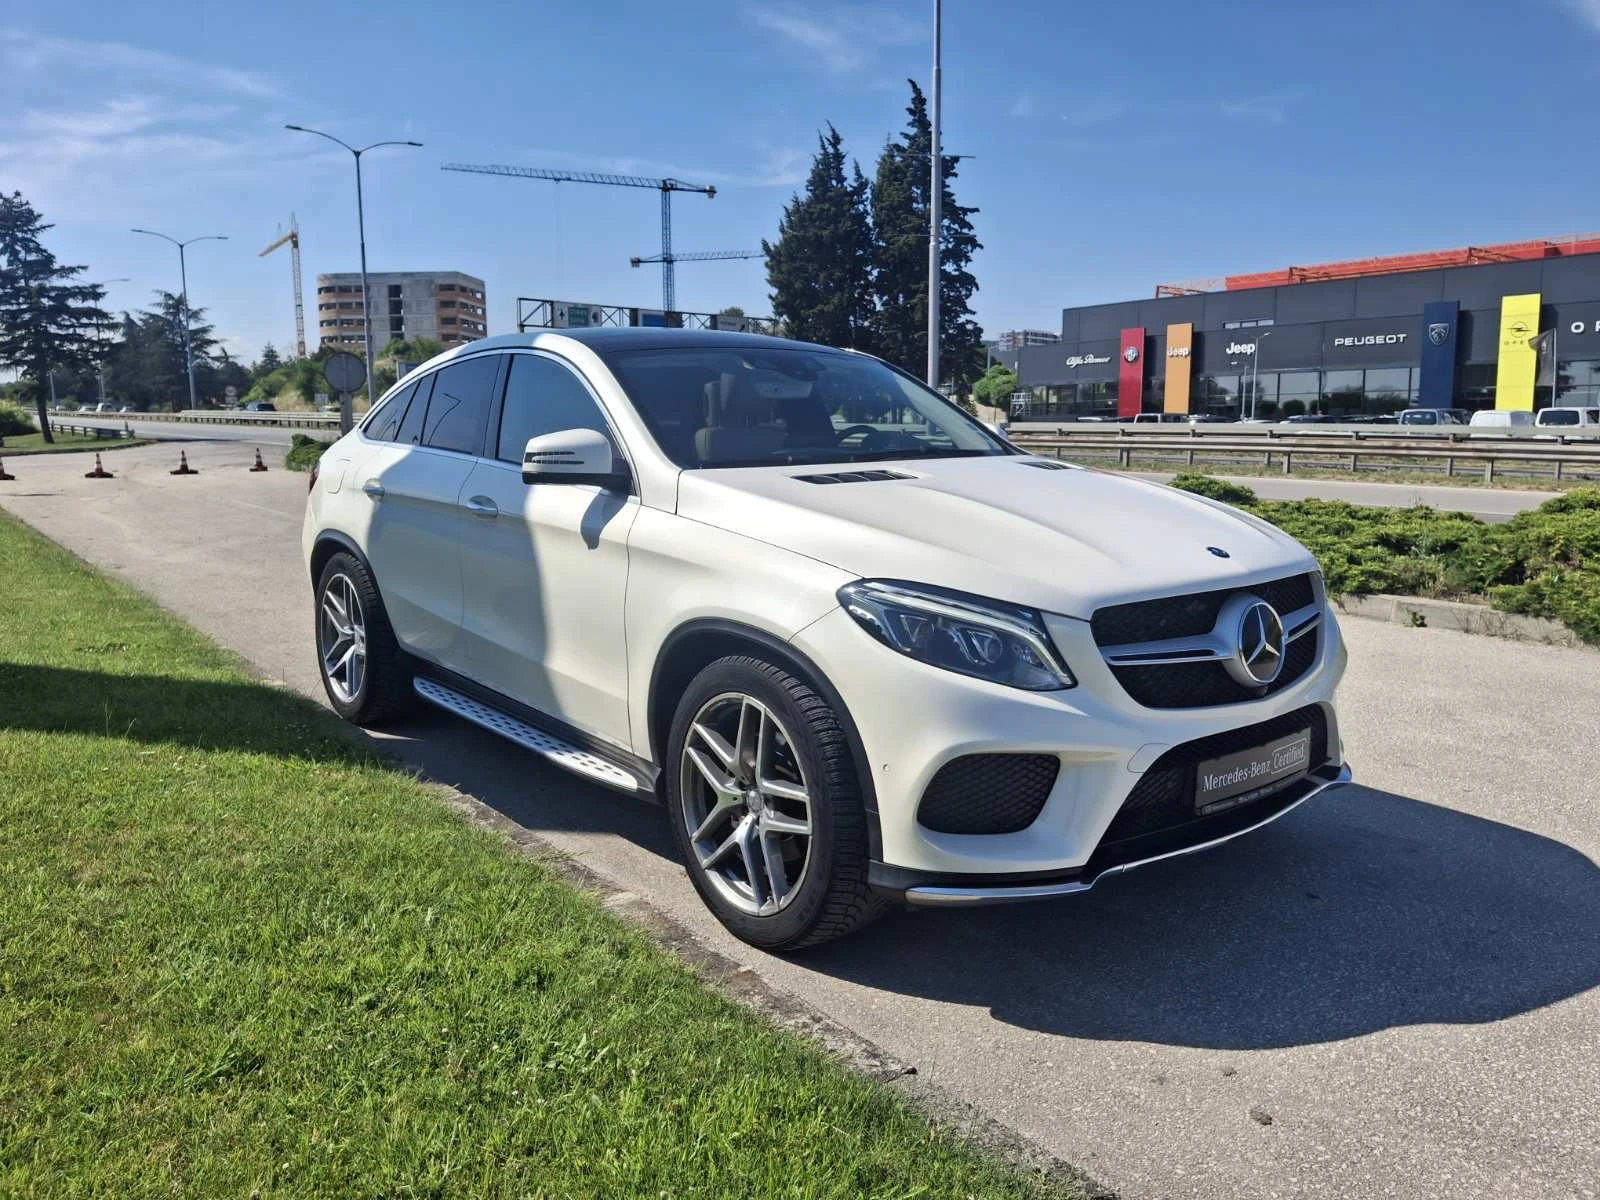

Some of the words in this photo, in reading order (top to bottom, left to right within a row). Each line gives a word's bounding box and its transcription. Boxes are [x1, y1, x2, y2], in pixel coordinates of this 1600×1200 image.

[1334, 333, 1407, 347] PEUGEOT
[1225, 341, 1256, 356] Jeep
[1202, 759, 1271, 792] Mercedes-Benz
[1273, 742, 1304, 769] Certified
